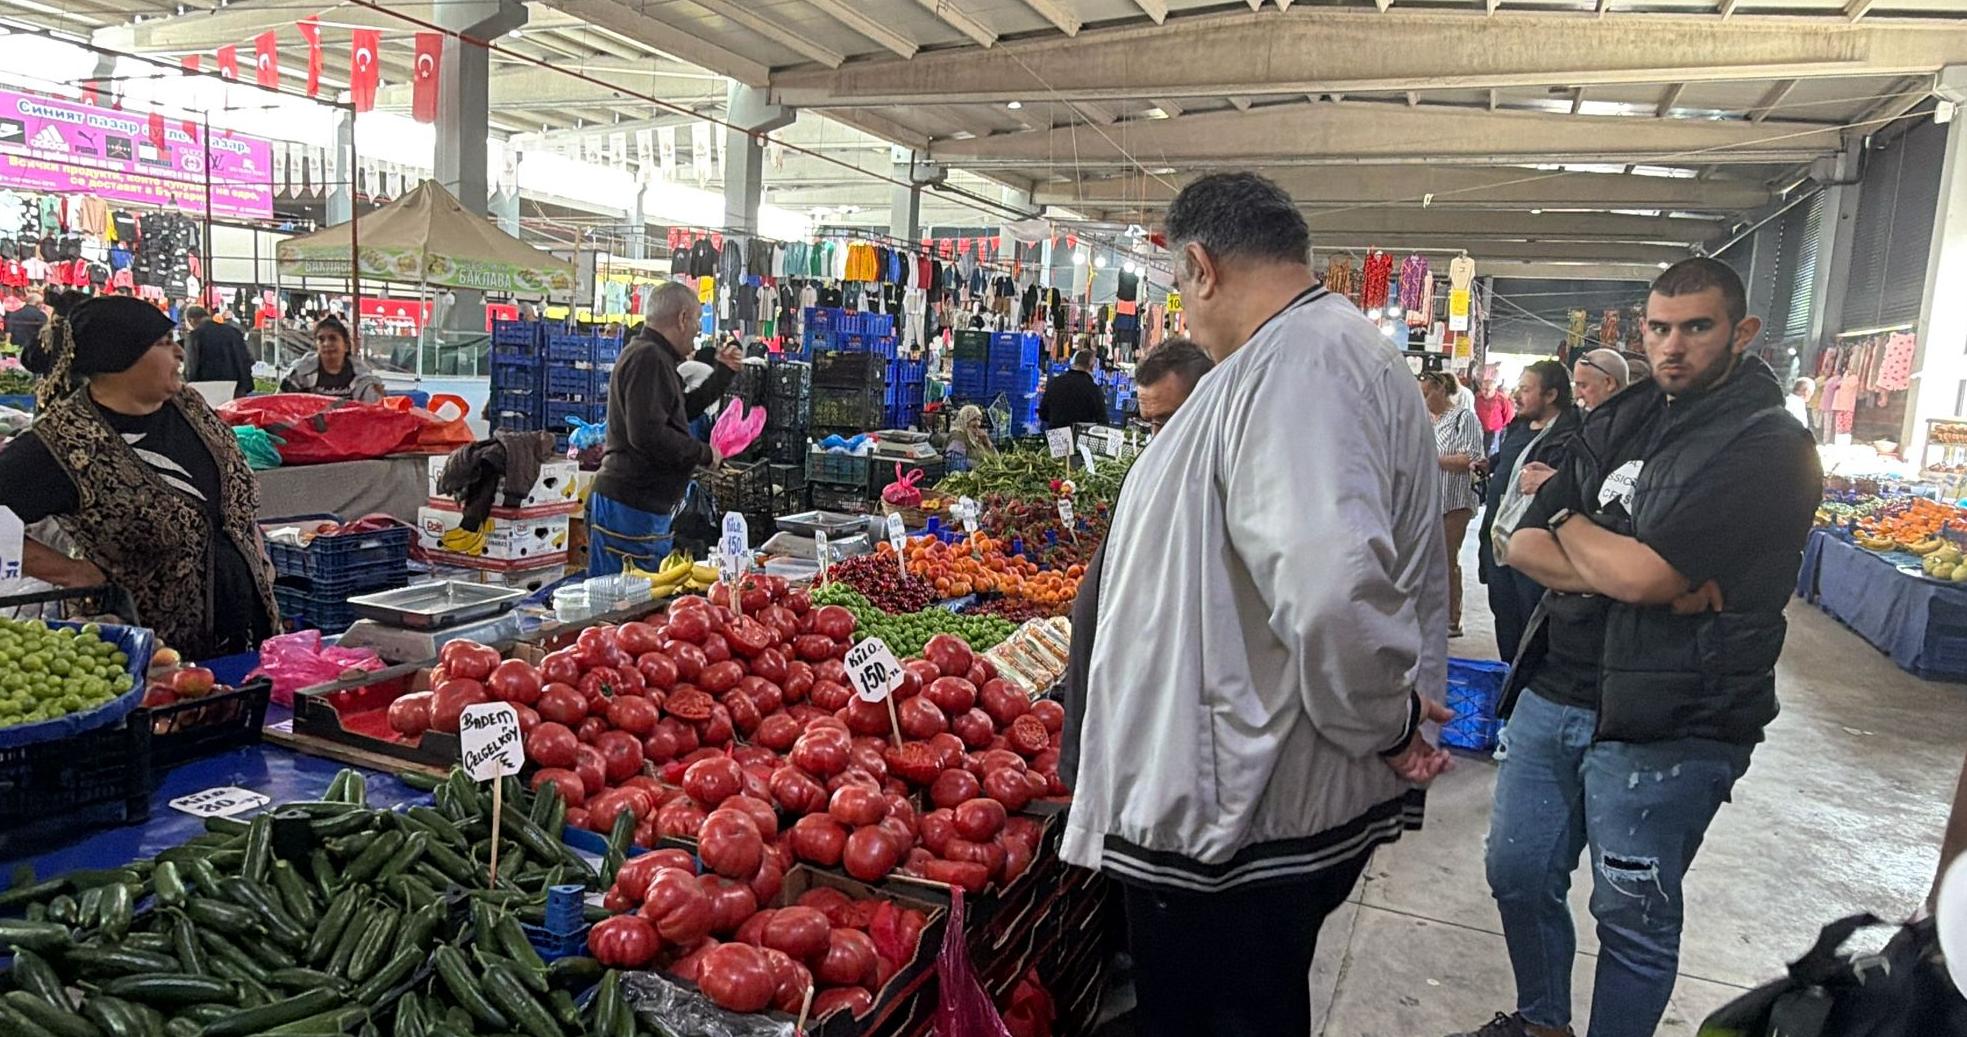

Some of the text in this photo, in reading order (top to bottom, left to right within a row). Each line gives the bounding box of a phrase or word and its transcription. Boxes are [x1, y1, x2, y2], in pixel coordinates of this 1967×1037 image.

[18, 100, 83, 122] Синият
[88, 114, 139, 134] пазар
[203, 136, 246, 153] азар
[458, 269, 511, 289] БАКЛАВА
[728, 535, 741, 555] 150
[859, 661, 887, 694] 150
[461, 710, 514, 732] BADEM
